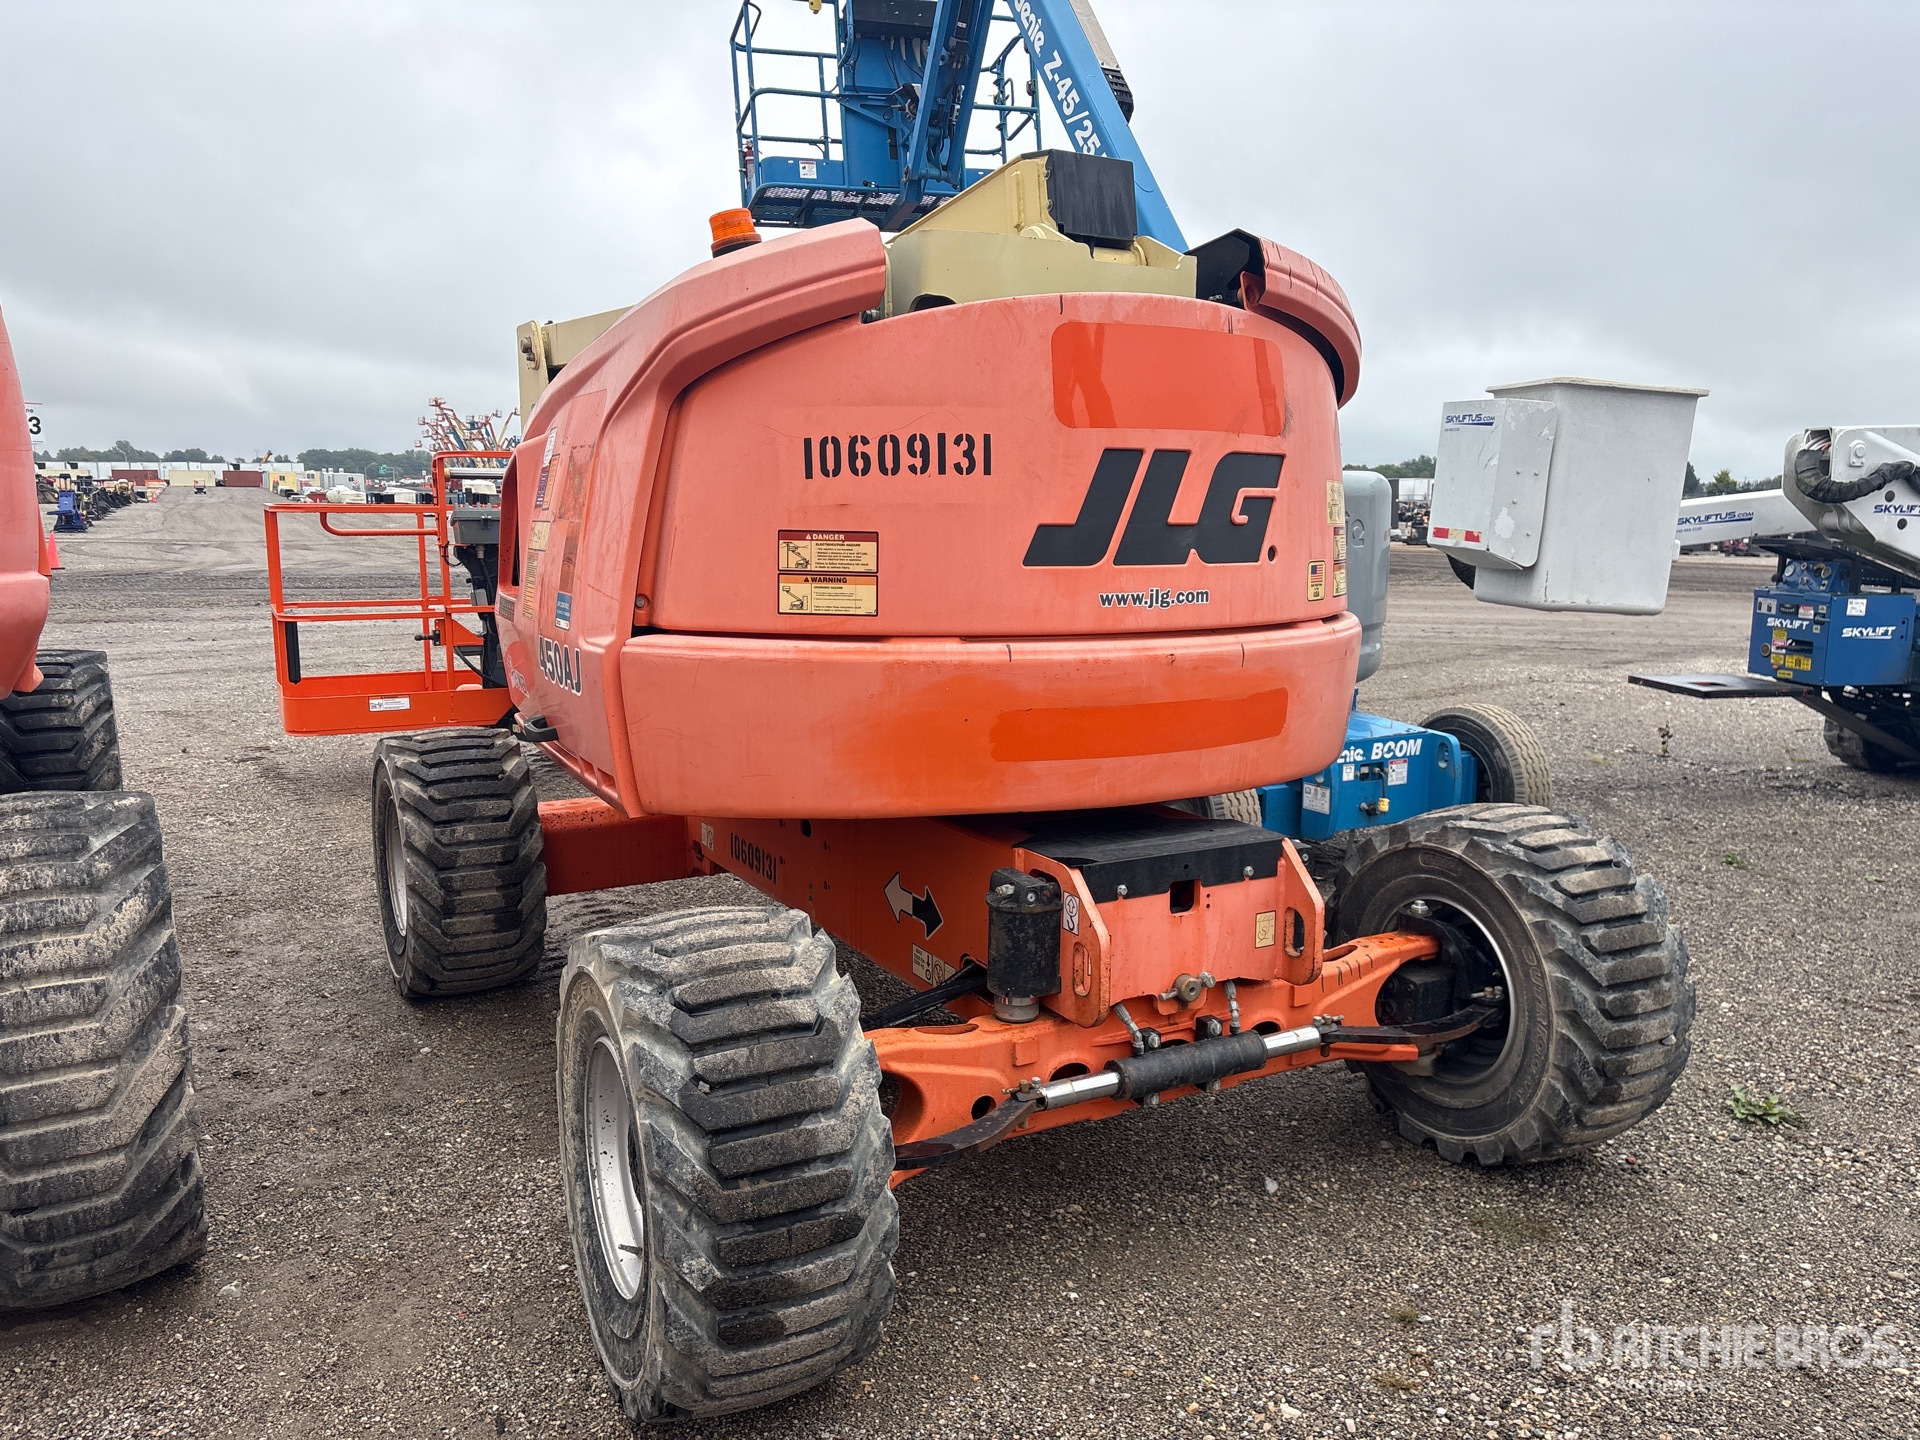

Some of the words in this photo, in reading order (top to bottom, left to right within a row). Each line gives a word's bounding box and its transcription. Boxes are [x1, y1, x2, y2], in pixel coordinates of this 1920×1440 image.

[1043, 49, 1107, 157] Z-45/25
[803, 432, 992, 480] 10609131
[1023, 448, 1285, 566] JLG
[1873, 504, 1920, 514] SKYLIF
[1099, 588, 1210, 609] www.jlg.com
[539, 636, 582, 696] 450AJ
[1371, 738, 1422, 760] BOOM
[730, 832, 777, 885] 10609131
